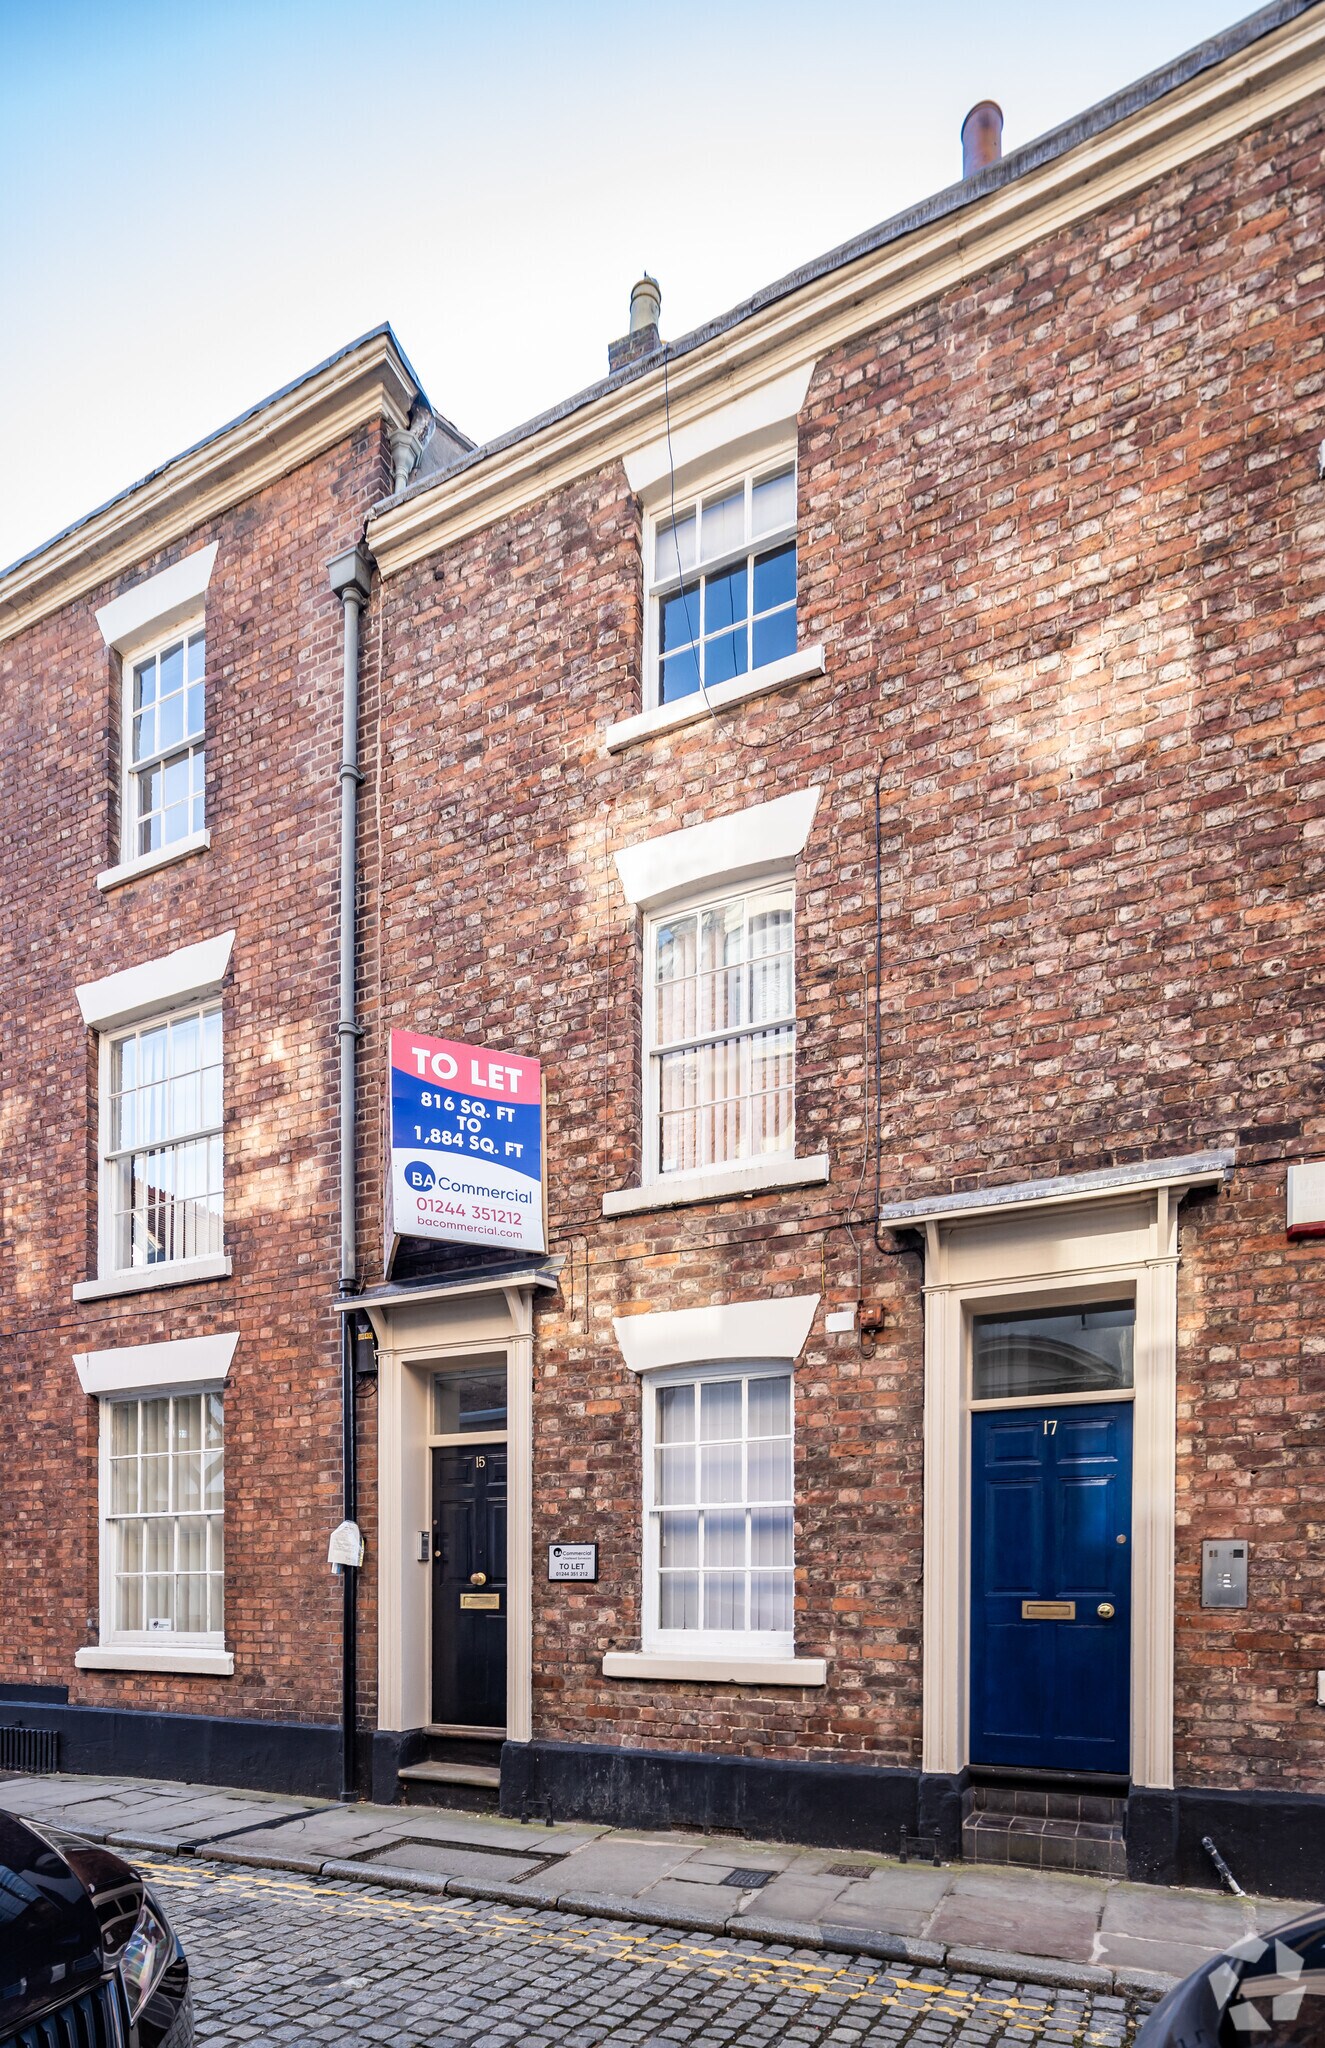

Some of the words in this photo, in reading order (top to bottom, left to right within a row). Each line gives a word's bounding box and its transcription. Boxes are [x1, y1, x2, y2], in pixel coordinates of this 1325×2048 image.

[411, 1047, 458, 1080] TO
[470, 1060, 523, 1093] LET
[420, 1091, 455, 1111] 816
[460, 1099, 491, 1119] SQ.
[496, 1106, 516, 1123] FT
[456, 1115, 482, 1133] TO
[413, 1125, 464, 1148] 1,884
[469, 1135, 499, 1155] SQ.
[505, 1141, 524, 1158] FT
[412, 1171, 435, 1189] BA
[438, 1176, 532, 1204] Commercial
[416, 1196, 466, 1217] 01244
[471, 1205, 522, 1226] 351212
[417, 1215, 523, 1239] bacommercial.com
[1043, 1420, 1058, 1435] 17
[475, 1455, 486, 1468] 15
